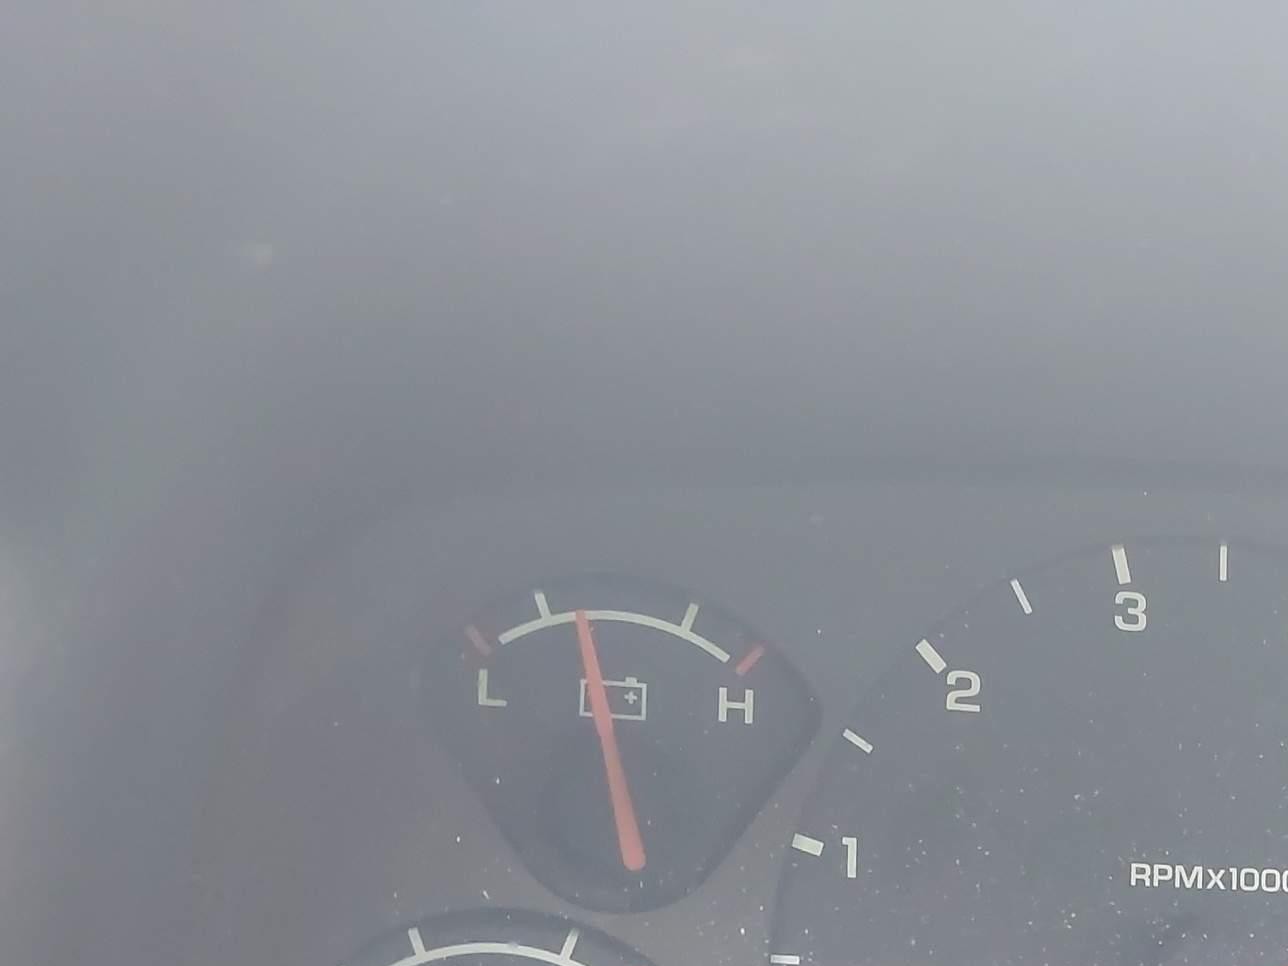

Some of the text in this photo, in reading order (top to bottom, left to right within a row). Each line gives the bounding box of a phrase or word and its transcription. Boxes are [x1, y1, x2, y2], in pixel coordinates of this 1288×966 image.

[1114, 591, 1147, 631] 3
[478, 669, 507, 707] L
[718, 687, 754, 723] H
[946, 670, 981, 712] 2
[842, 837, 858, 878] 1
